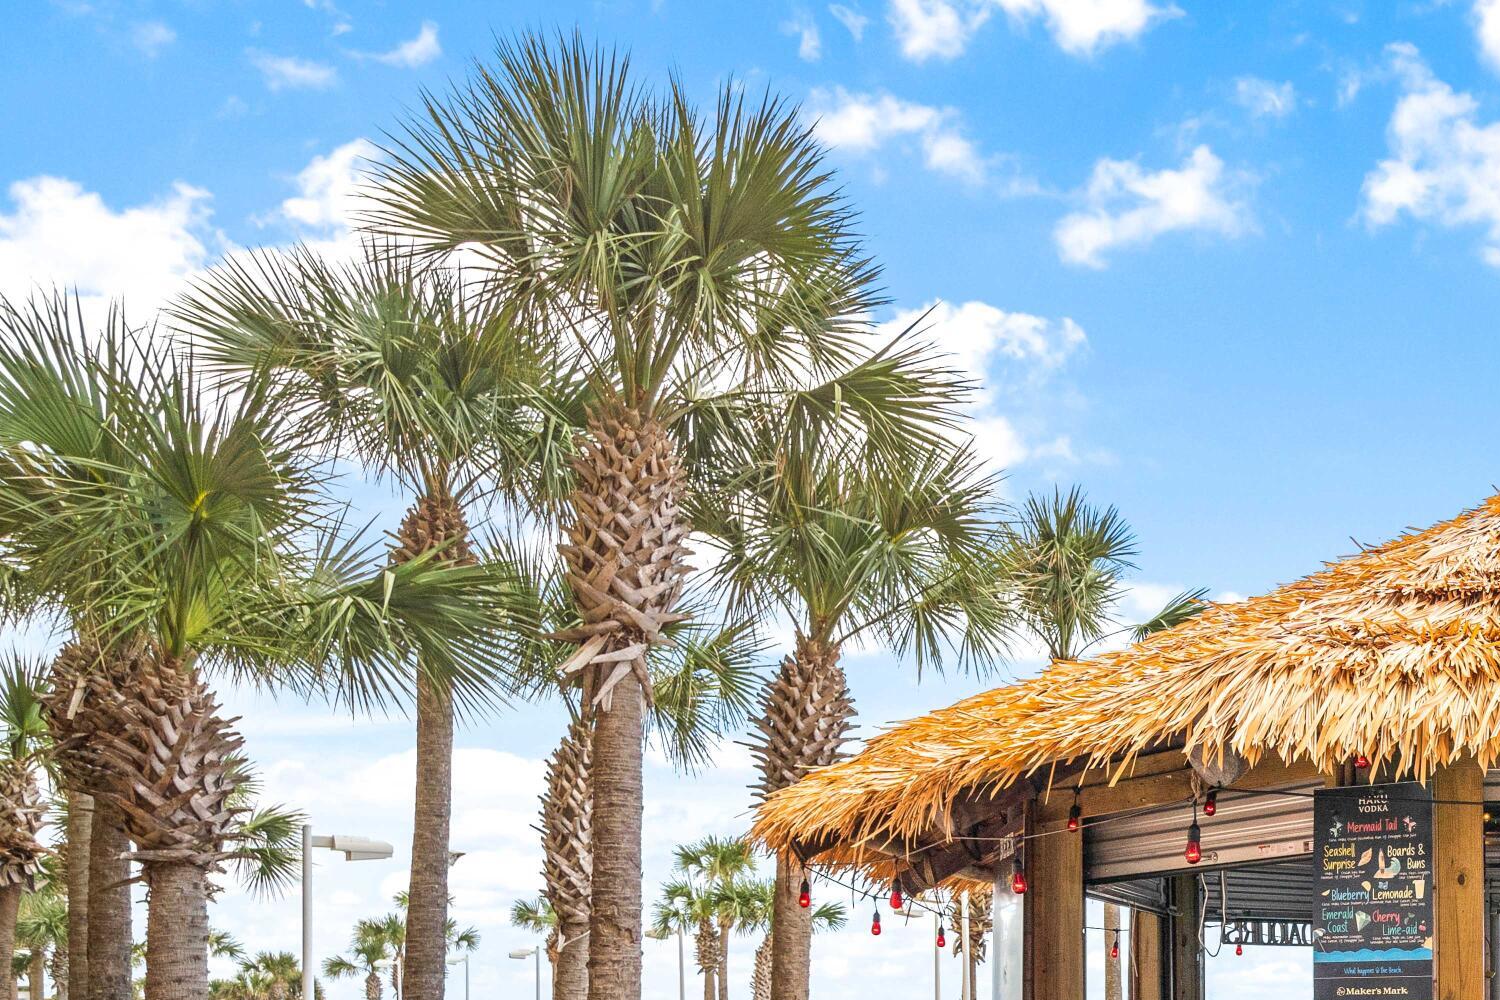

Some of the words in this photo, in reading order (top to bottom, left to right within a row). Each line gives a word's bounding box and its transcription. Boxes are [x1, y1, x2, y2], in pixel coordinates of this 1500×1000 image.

[1347, 818, 1382, 832] Mermaid
[1385, 817, 1398, 831] Tail
[1324, 843, 1355, 857] Seashell
[1388, 843, 1415, 857] Boards
[1418, 844, 1425, 855] &
[1324, 858, 1355, 873] Surprise
[1407, 858, 1425, 869] Buns
[1332, 888, 1369, 904] Blueberry
[1372, 885, 1413, 900] Lemonade
[1322, 906, 1353, 920] Emerald
[1372, 909, 1400, 926] Cherry
[1327, 921, 1348, 933] Coast
[1383, 922, 1417, 935] Lime-aid
